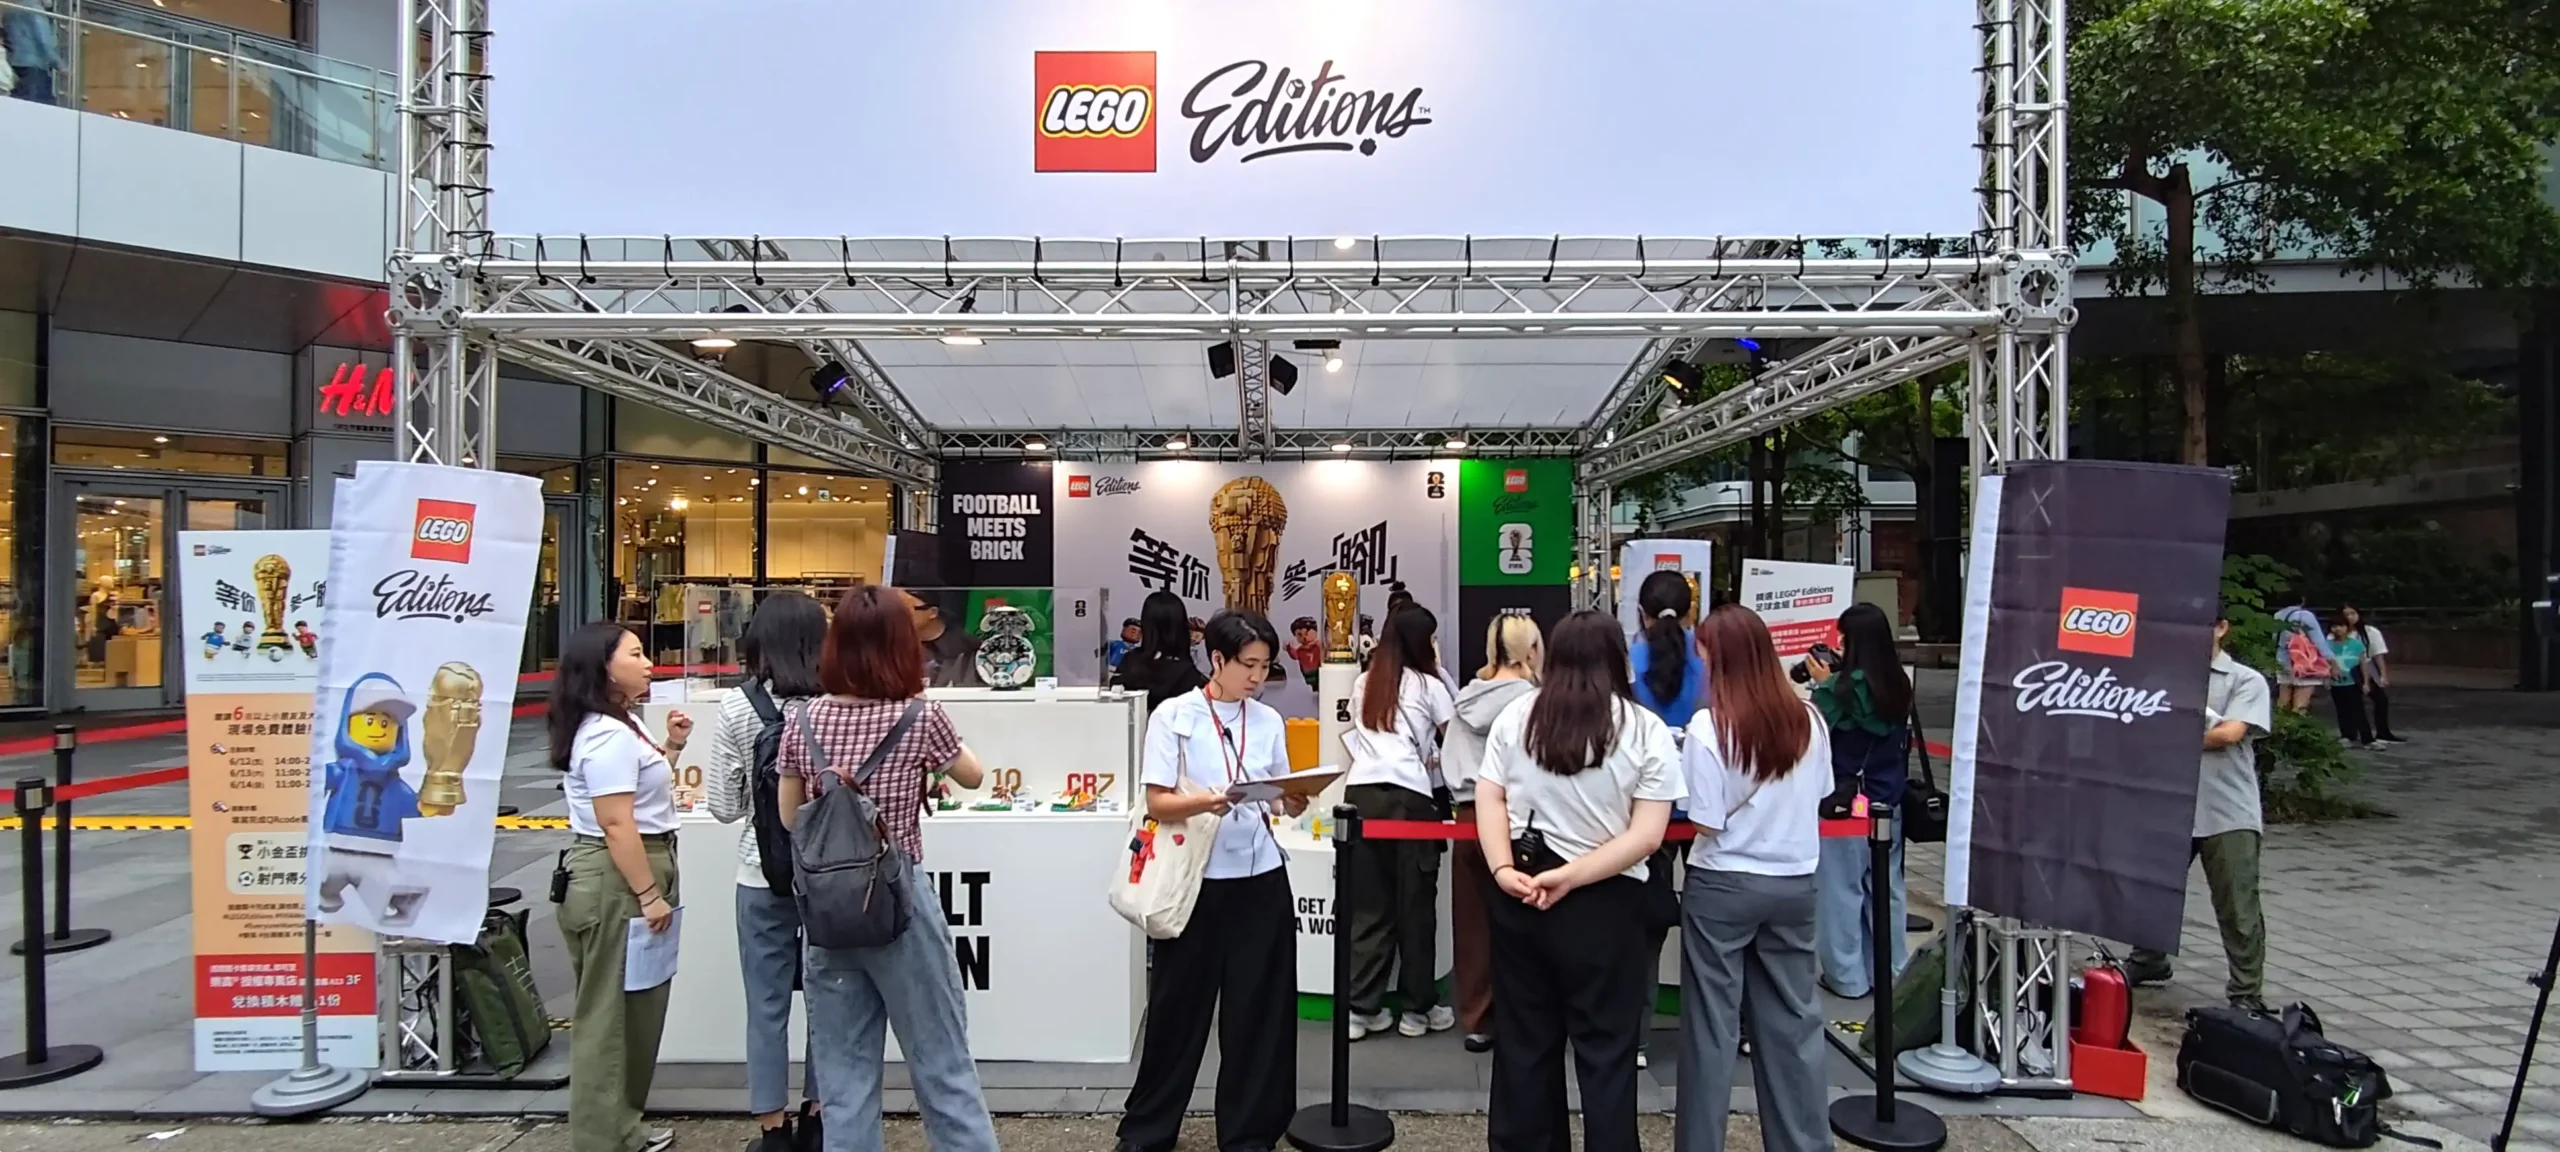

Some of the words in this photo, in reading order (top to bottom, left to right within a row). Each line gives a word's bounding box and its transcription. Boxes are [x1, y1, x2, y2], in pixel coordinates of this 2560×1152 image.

[1041, 86, 1151, 136] LEGO
[1181, 60, 1432, 163] Editions
[1070, 482, 1089, 491] LEGO
[1095, 477, 1141, 496] Editions
[953, 494, 1040, 514] FOOTBALL
[418, 516, 470, 545] LEGO
[967, 517, 1026, 537] MEETS
[970, 541, 1024, 560] BRICK
[373, 570, 494, 623] Editions
[1802, 586, 1834, 595] Editions
[2062, 605, 2134, 638] LEGO
[2013, 661, 2171, 724] Editions
[1298, 897, 1326, 915] GET
[346, 975, 361, 985] 3F
